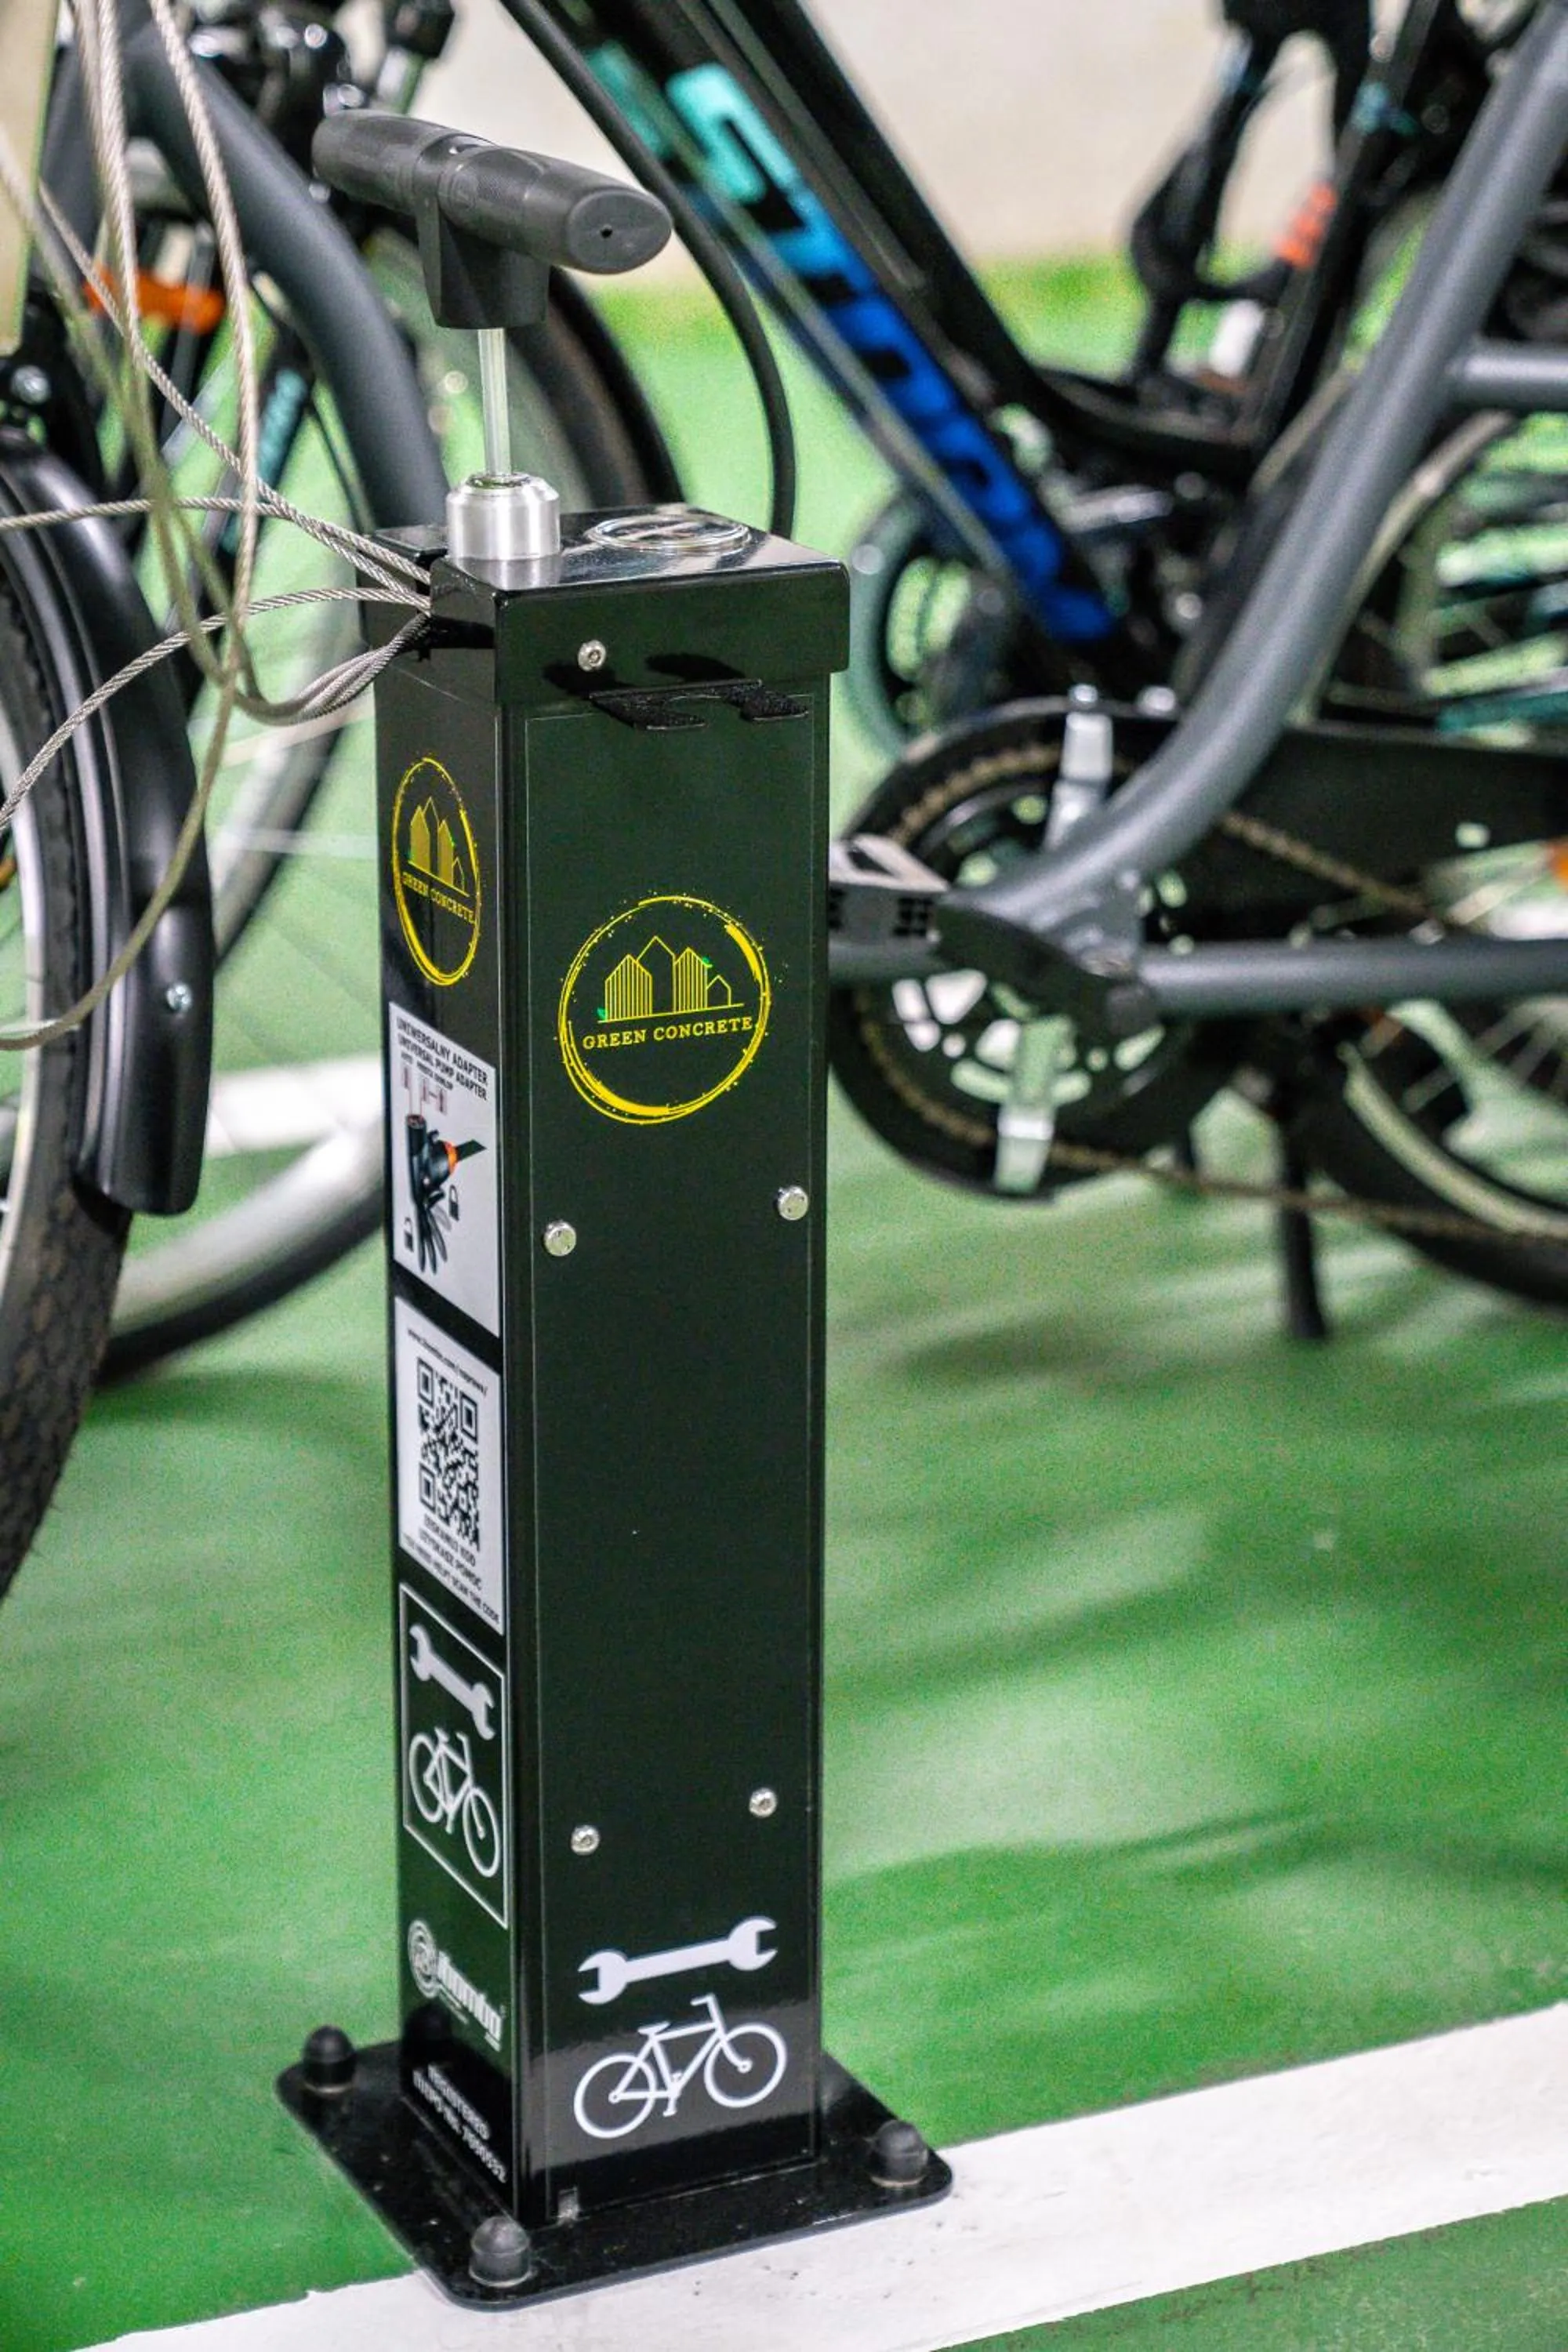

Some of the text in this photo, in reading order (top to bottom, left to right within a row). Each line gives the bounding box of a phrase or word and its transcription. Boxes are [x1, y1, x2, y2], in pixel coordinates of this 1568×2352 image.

[430, 887, 475, 925] CONCRETE
[583, 1017, 753, 1050] GREEN CONCRETE
[452, 1053, 488, 1086] ADAPTER
[456, 1072, 487, 1102] ADAPTER
